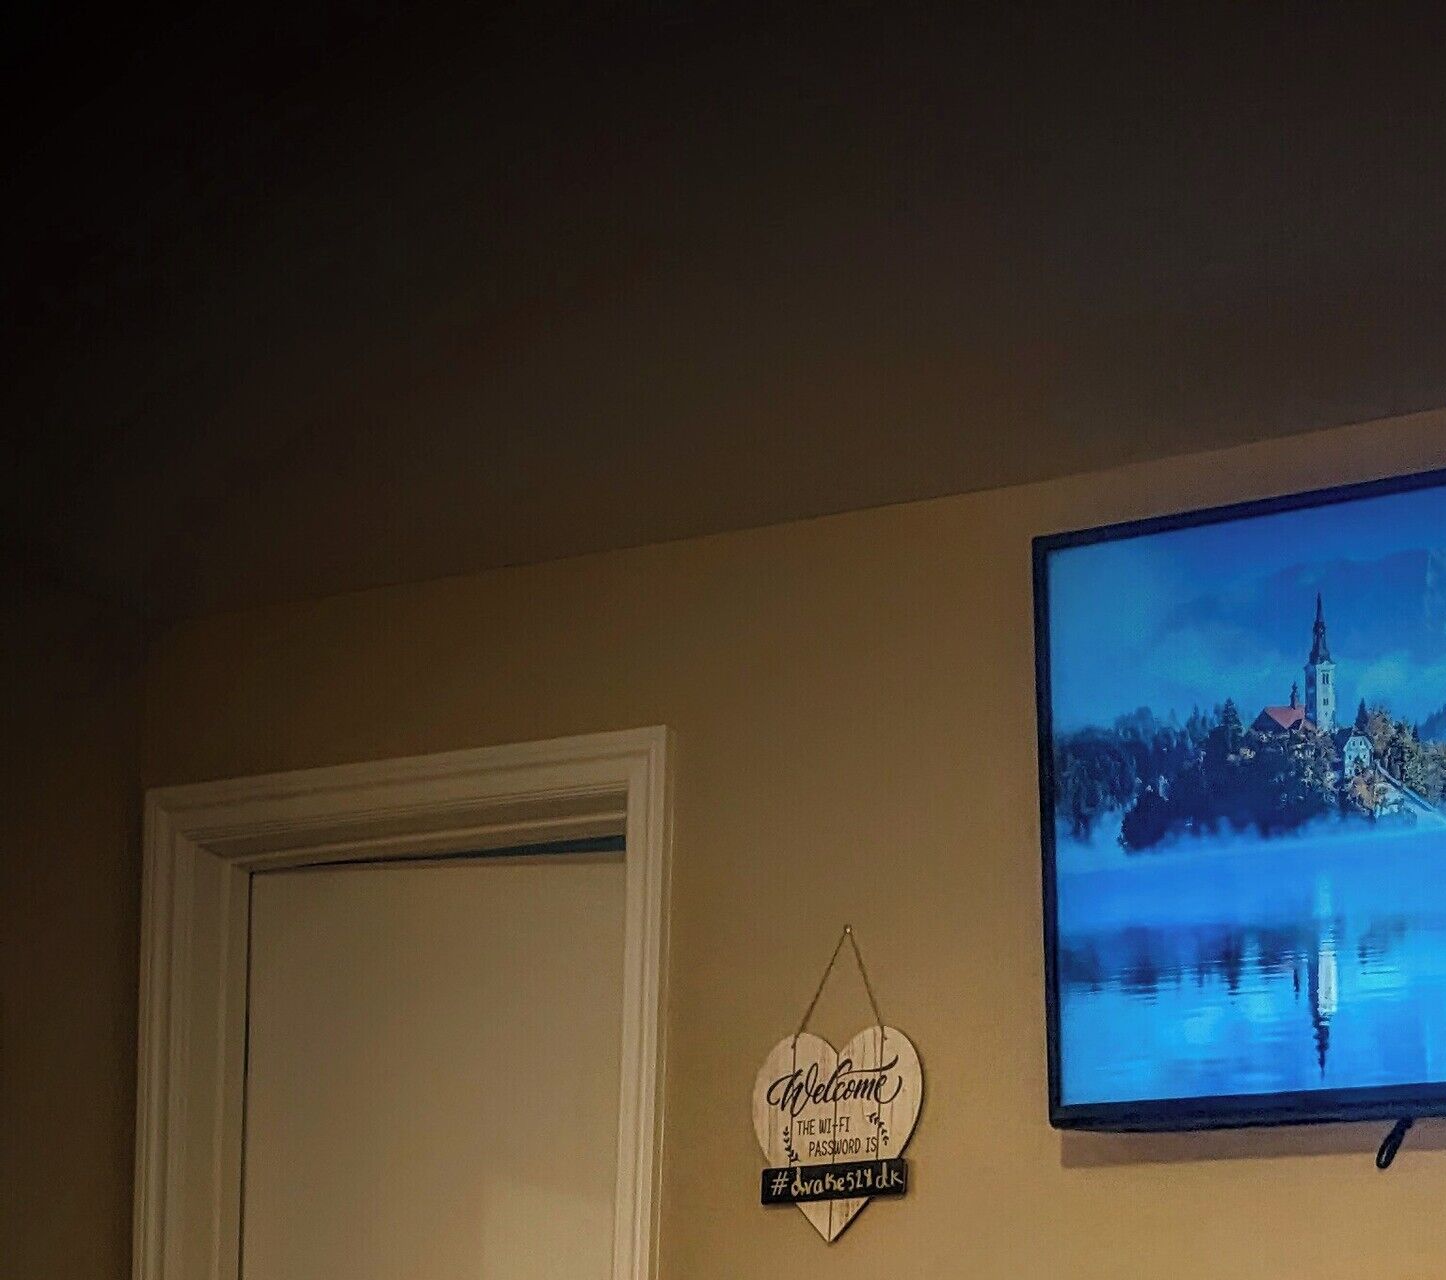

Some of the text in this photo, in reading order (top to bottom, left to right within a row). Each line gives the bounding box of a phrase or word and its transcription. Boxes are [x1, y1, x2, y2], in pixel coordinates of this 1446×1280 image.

[766, 1055, 903, 1117] Welcome
[797, 1116, 851, 1136] THE WI-FI
[808, 1137, 879, 1158] PASSWORD IS
